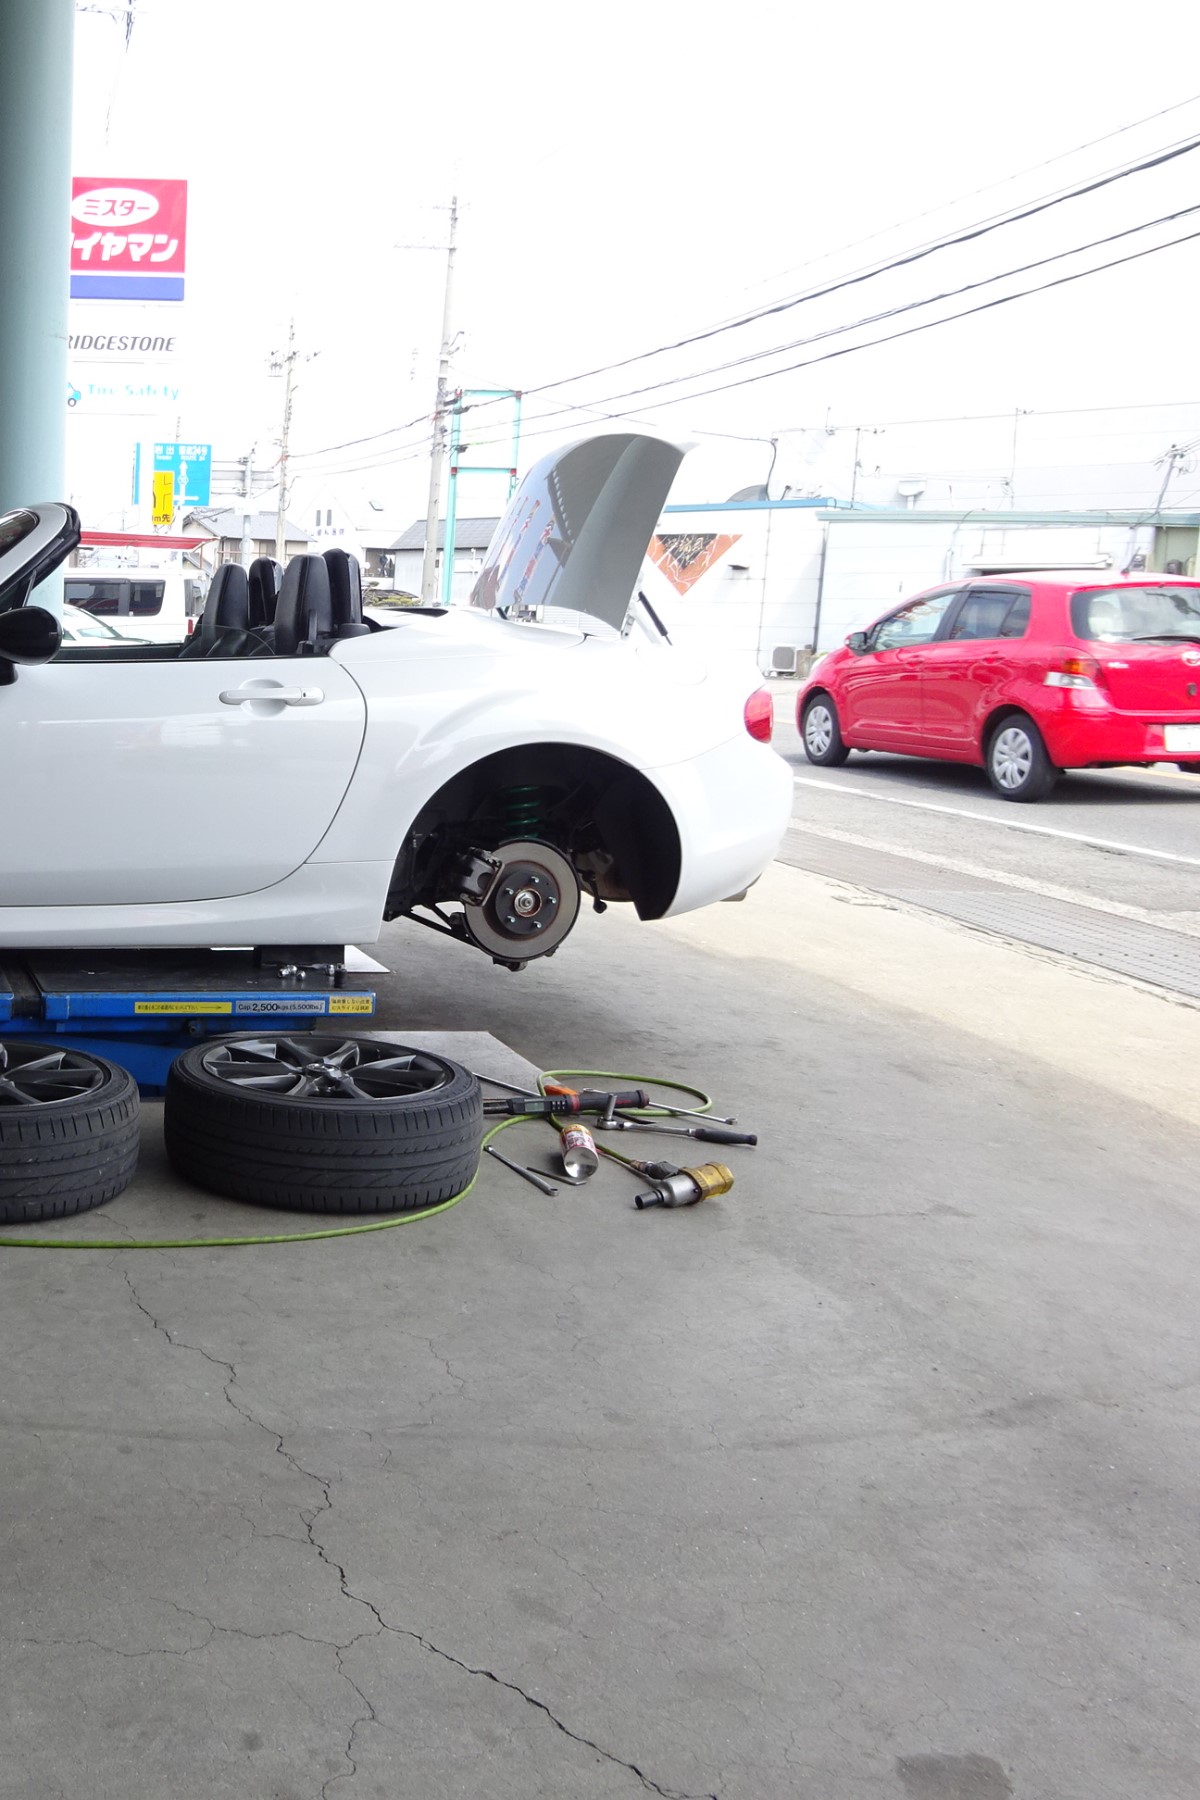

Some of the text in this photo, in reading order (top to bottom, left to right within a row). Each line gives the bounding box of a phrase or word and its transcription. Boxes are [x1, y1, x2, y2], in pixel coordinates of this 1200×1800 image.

[83, 199, 150, 216] ミスター
[71, 232, 179, 263] イヤマン
[125, 384, 179, 401] Safety
[152, 514, 170, 523] m先
